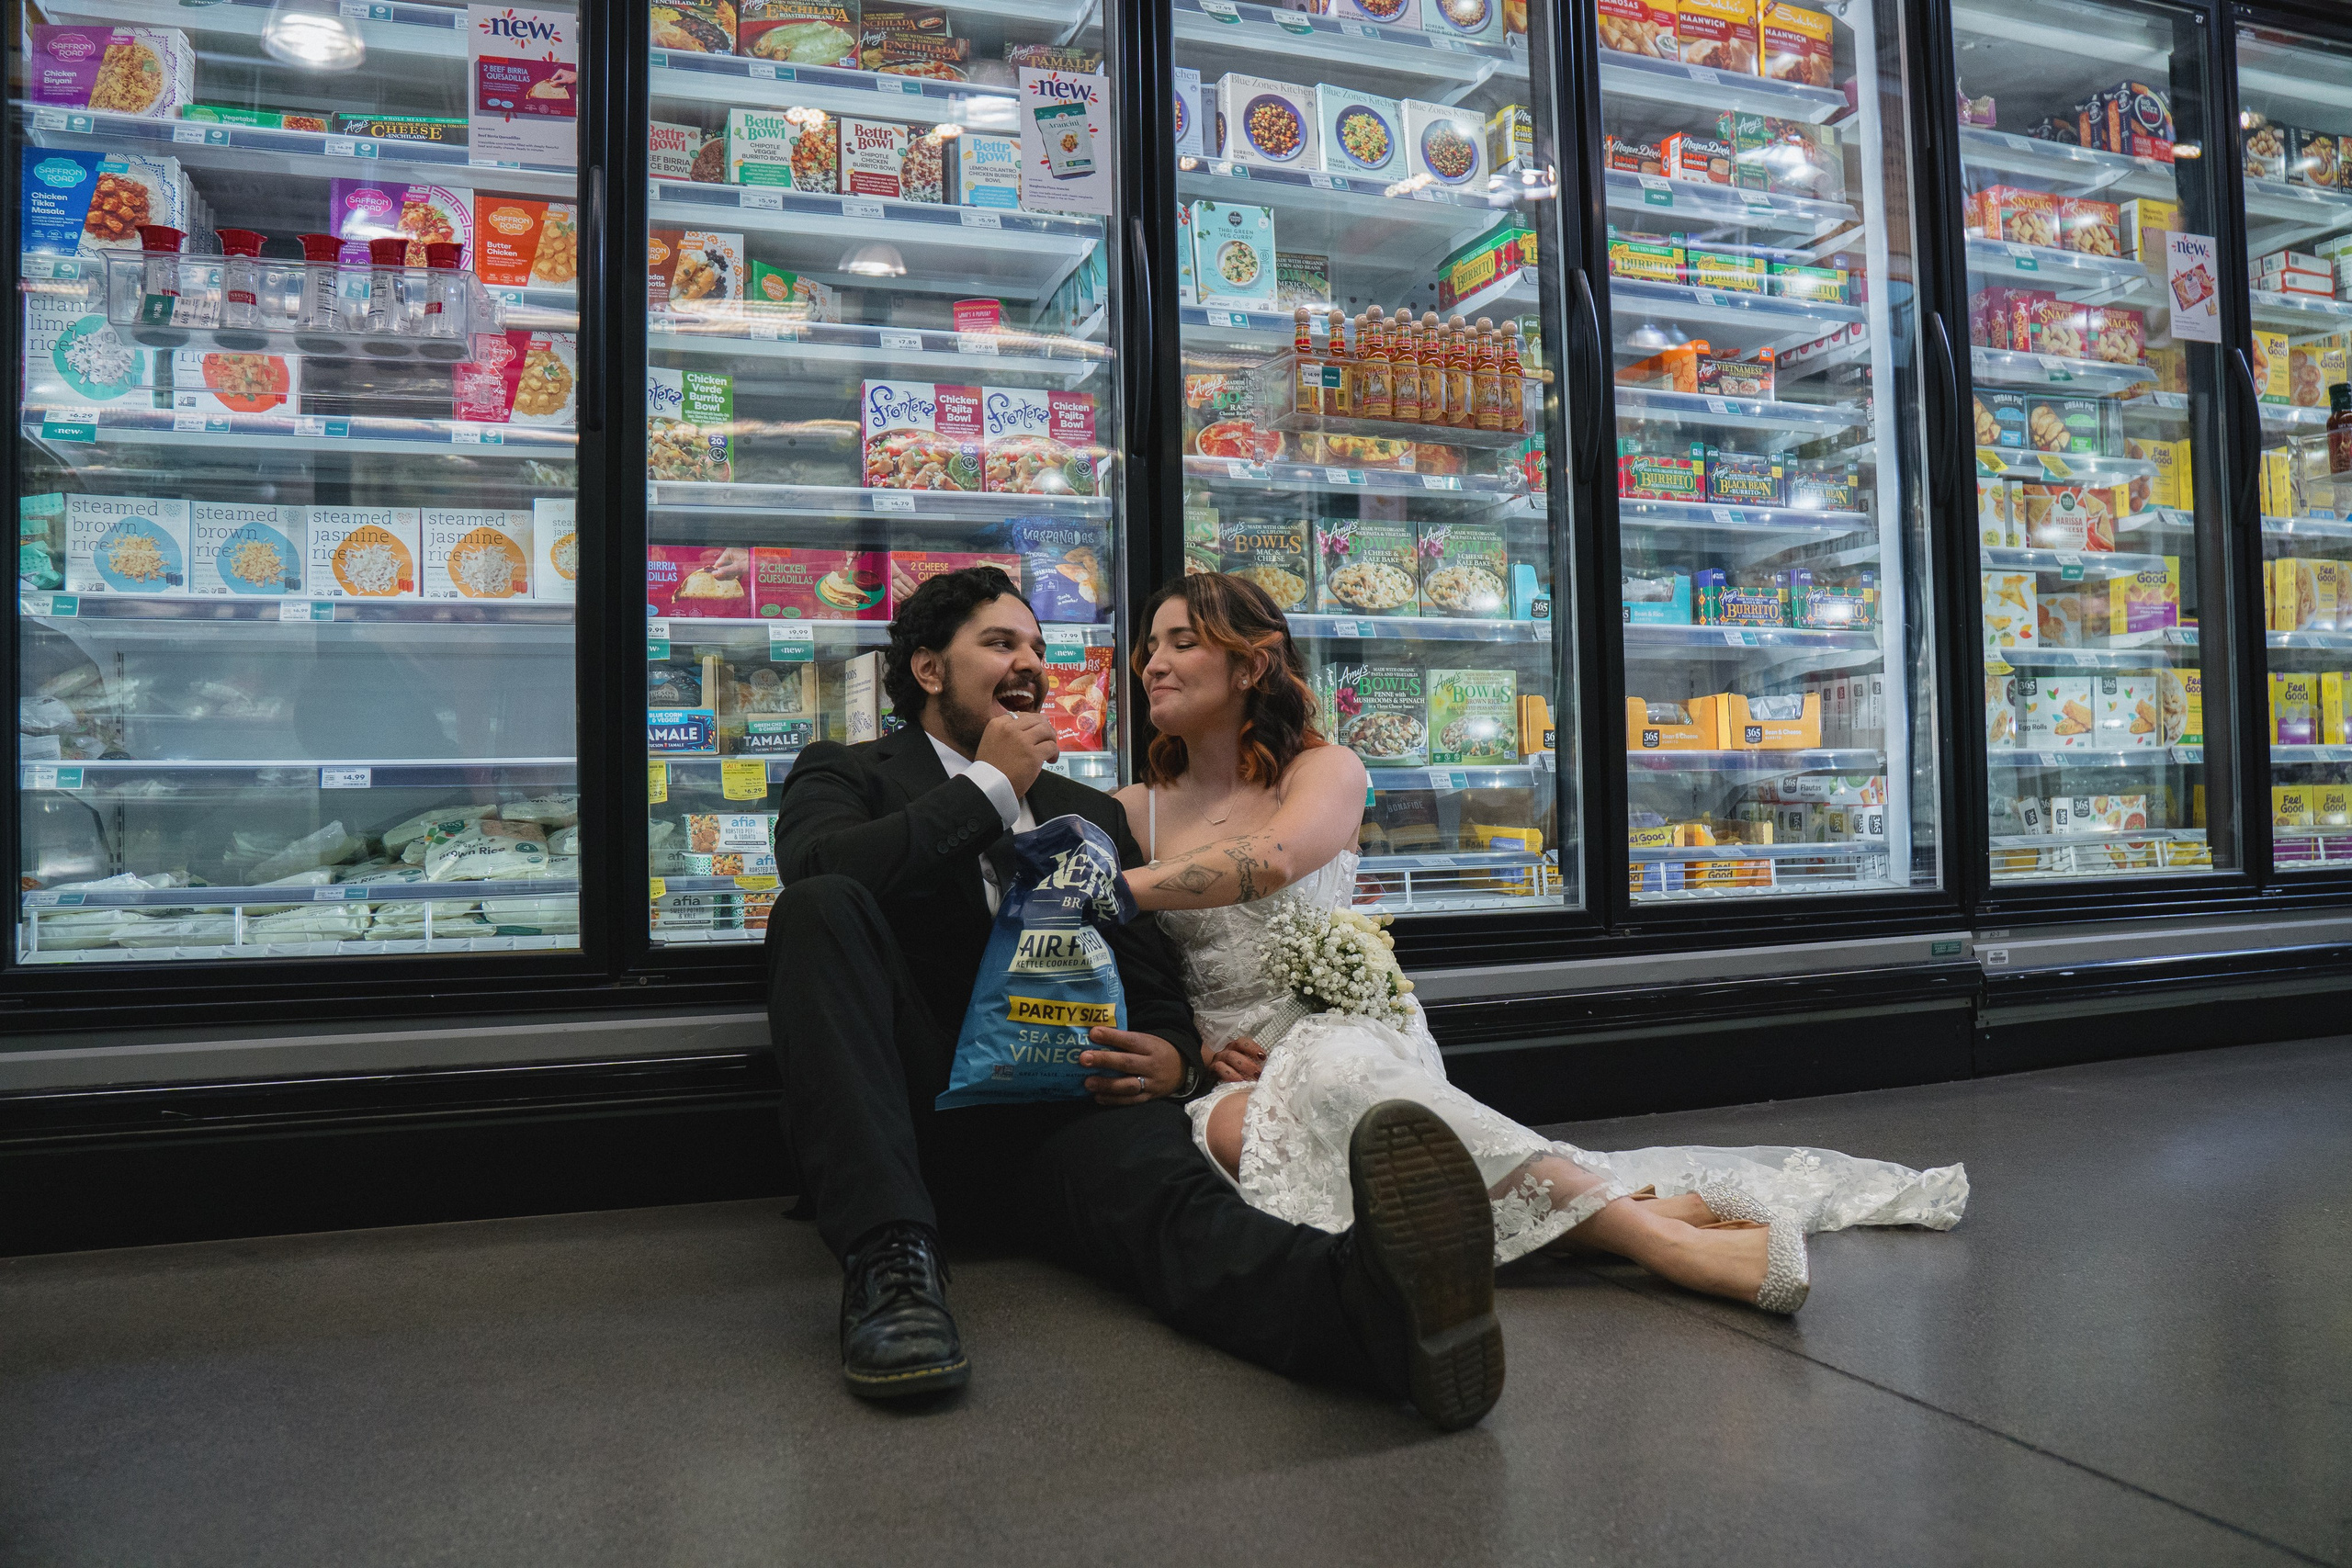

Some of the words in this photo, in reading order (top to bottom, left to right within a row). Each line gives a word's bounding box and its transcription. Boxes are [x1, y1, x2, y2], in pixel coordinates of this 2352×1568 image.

[765, 5, 850, 23] ENCHILADA
[2196, 15, 2203, 24] 27
[1680, 14, 1725, 28] NAANWICH
[491, 18, 555, 39] new
[1765, 28, 1806, 43] NAANWICH
[51, 41, 91, 51] SAFFRON
[59, 49, 84, 57] ROAD
[44, 76, 72, 85] Biryani
[486, 73, 530, 83] QUESADILLAS
[1038, 79, 1091, 100] new
[1231, 75, 1250, 85] Blue
[1251, 79, 1279, 91] Zones
[1280, 82, 1314, 96] Kitchen
[1408, 101, 1427, 111] Blue
[1428, 105, 1453, 116] Zones
[1453, 108, 1484, 121] Kitchen
[2140, 106, 2159, 115] MOZZ
[222, 114, 257, 124] Vegetable
[744, 114, 784, 129] Bettr
[1049, 119, 1080, 129] Arancini
[371, 125, 442, 140] CHEESE
[854, 124, 892, 139] Bettr
[972, 139, 1011, 154] Bettr
[1683, 152, 1707, 161] SPICY
[38, 165, 83, 176] SAFFRON
[989, 166, 1017, 175] CILANTRO
[31, 192, 68, 201] Chicken
[349, 195, 389, 206] SAFFRON
[31, 199, 55, 208] Tikka
[2011, 197, 2053, 216] SNACKS
[31, 207, 65, 215] Masala
[492, 214, 530, 224] SAFFRON
[498, 221, 525, 230] ROAD
[487, 242, 512, 250] Butter
[2176, 240, 2206, 257] new
[487, 248, 517, 256] Chicken
[28, 315, 77, 332] lime
[29, 338, 70, 351] rice
[1717, 364, 1763, 375] VIETNAMESE
[686, 373, 728, 387] Chicken
[692, 383, 722, 395] Verde
[689, 392, 725, 403] Burrito
[939, 395, 978, 405] Chicken
[1993, 395, 2010, 404] URBAN
[2011, 395, 2023, 404] PIE
[695, 401, 719, 412] Bowl
[944, 403, 973, 415] Fajita
[1053, 402, 1090, 412] Chicken
[2064, 401, 2082, 410] URBAN
[2083, 401, 2095, 412] PIE
[946, 412, 971, 423] Bowl
[1058, 411, 1085, 421] Fajita
[1060, 419, 1084, 429] Bowl
[1641, 473, 1694, 489] BURRITO
[72, 500, 159, 516] steamed
[196, 506, 278, 523] steamed
[312, 510, 392, 525] steamed
[428, 512, 505, 526] steamed
[73, 517, 138, 535] brown
[2056, 517, 2083, 525] HARISSA
[197, 524, 258, 540] brown
[311, 529, 390, 545] jasmine
[1023, 528, 1094, 545] MASPANADAS
[428, 531, 503, 547] jasmine
[1235, 536, 1301, 553] BOWLS
[1349, 536, 1411, 556] BOWLS
[428, 549, 461, 561] rice
[760, 563, 764, 572] 2
[766, 564, 807, 574] CHICKEN
[918, 562, 949, 570] CHEESE
[759, 574, 813, 585] QUESADILLAS
[2137, 572, 2166, 583] Good
[1532, 601, 1547, 613] 365
[1726, 604, 1779, 618] BURRITO
[1358, 677, 1420, 695] BOWLS
[2019, 681, 2035, 690] 365
[2103, 680, 2116, 688] 365
[2288, 682, 2306, 692] Feel
[1453, 685, 1511, 704] BOWLS
[2285, 691, 2308, 701] Good
[743, 734, 798, 747] TAMALE
[344, 773, 366, 783] $4.99
[1800, 784, 1821, 792] Flautas
[1387, 801, 1424, 814] BONAFIDE
[2075, 801, 2088, 810] 365
[2280, 803, 2304, 814] Good
[731, 817, 756, 827] afia
[1020, 935, 1062, 957] AIR
[1016, 960, 1044, 968] KETTLE
[1046, 960, 1079, 968] COOKED
[1019, 1002, 1077, 1021] PARTY
[1080, 1009, 1109, 1022] SIZE
[1019, 1030, 1051, 1043] SEA
[1056, 1033, 1091, 1045] SALT
